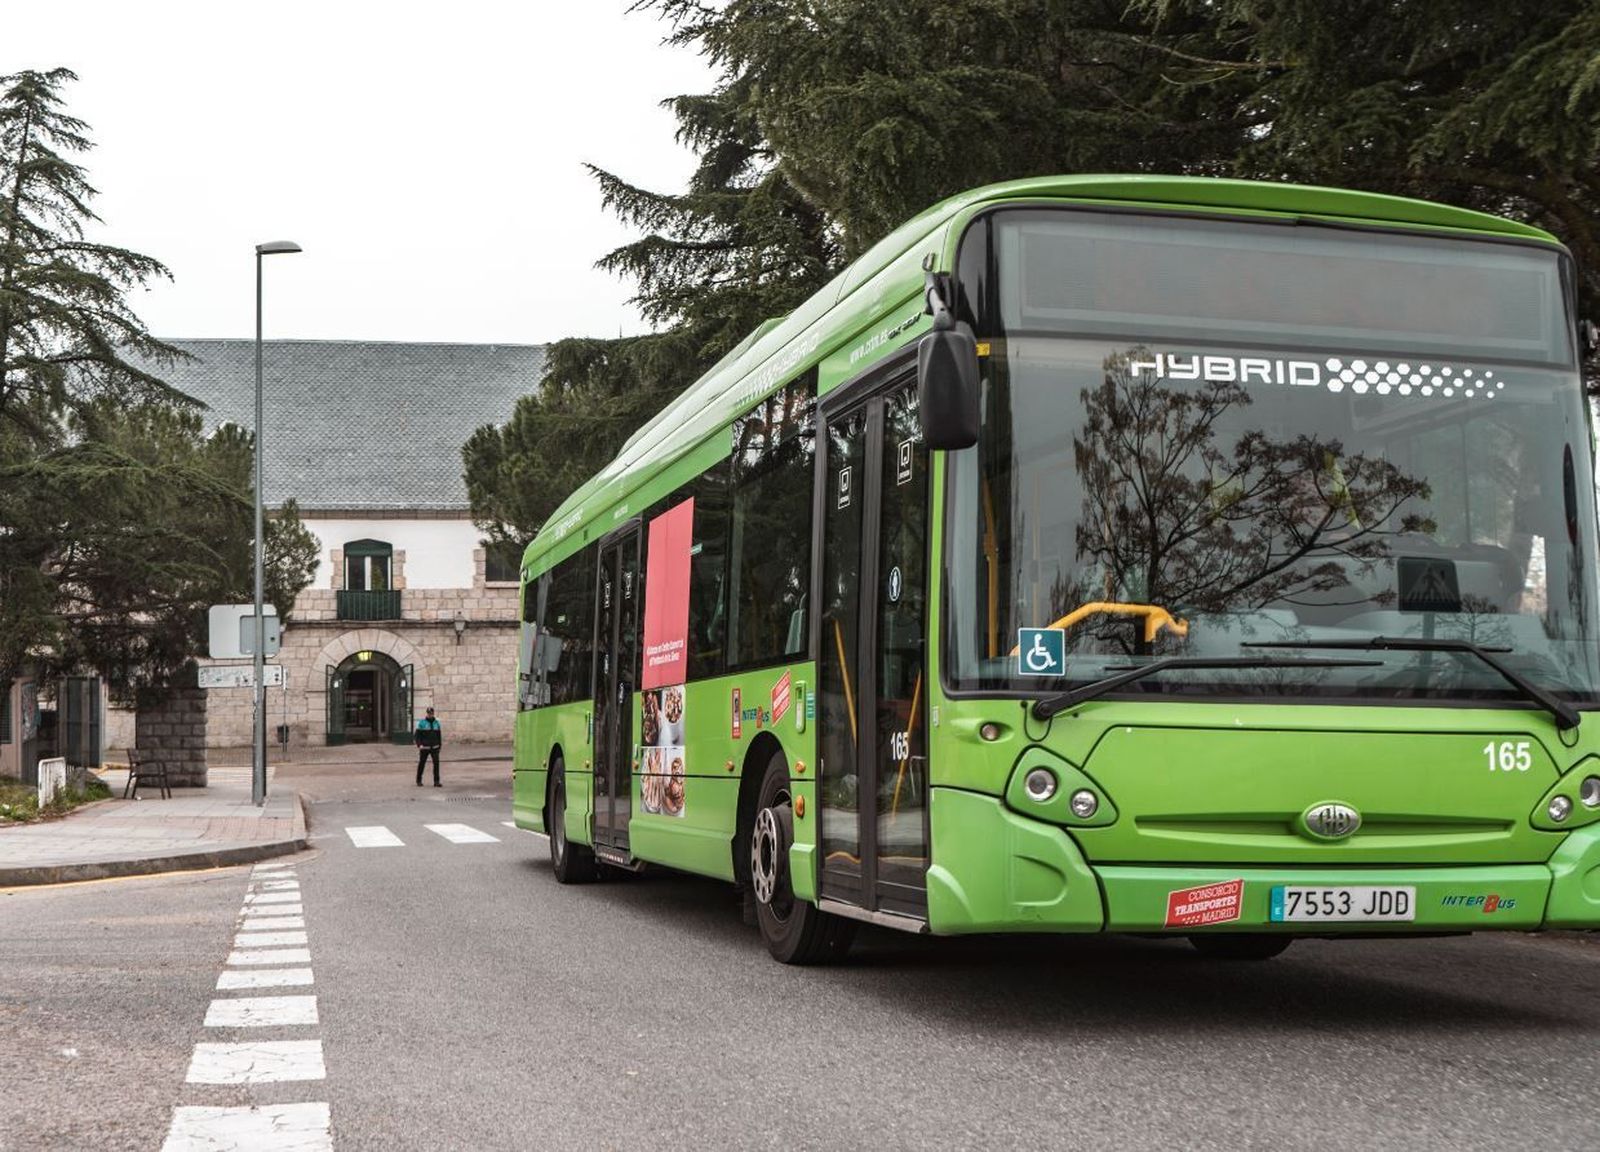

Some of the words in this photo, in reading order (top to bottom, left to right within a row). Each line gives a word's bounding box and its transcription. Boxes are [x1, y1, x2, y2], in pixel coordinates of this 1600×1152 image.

[1128, 353, 1321, 386] HYBRID
[890, 731, 910, 760] 165
[1483, 741, 1532, 772] 165
[1188, 883, 1239, 902] CONSORCIO
[1288, 891, 1351, 916] 7553
[1362, 891, 1409, 915] JDD
[1441, 894, 1515, 913] INTERBUS
[1174, 895, 1237, 917] TRANSPORTES
[1201, 907, 1236, 923] MADRID
